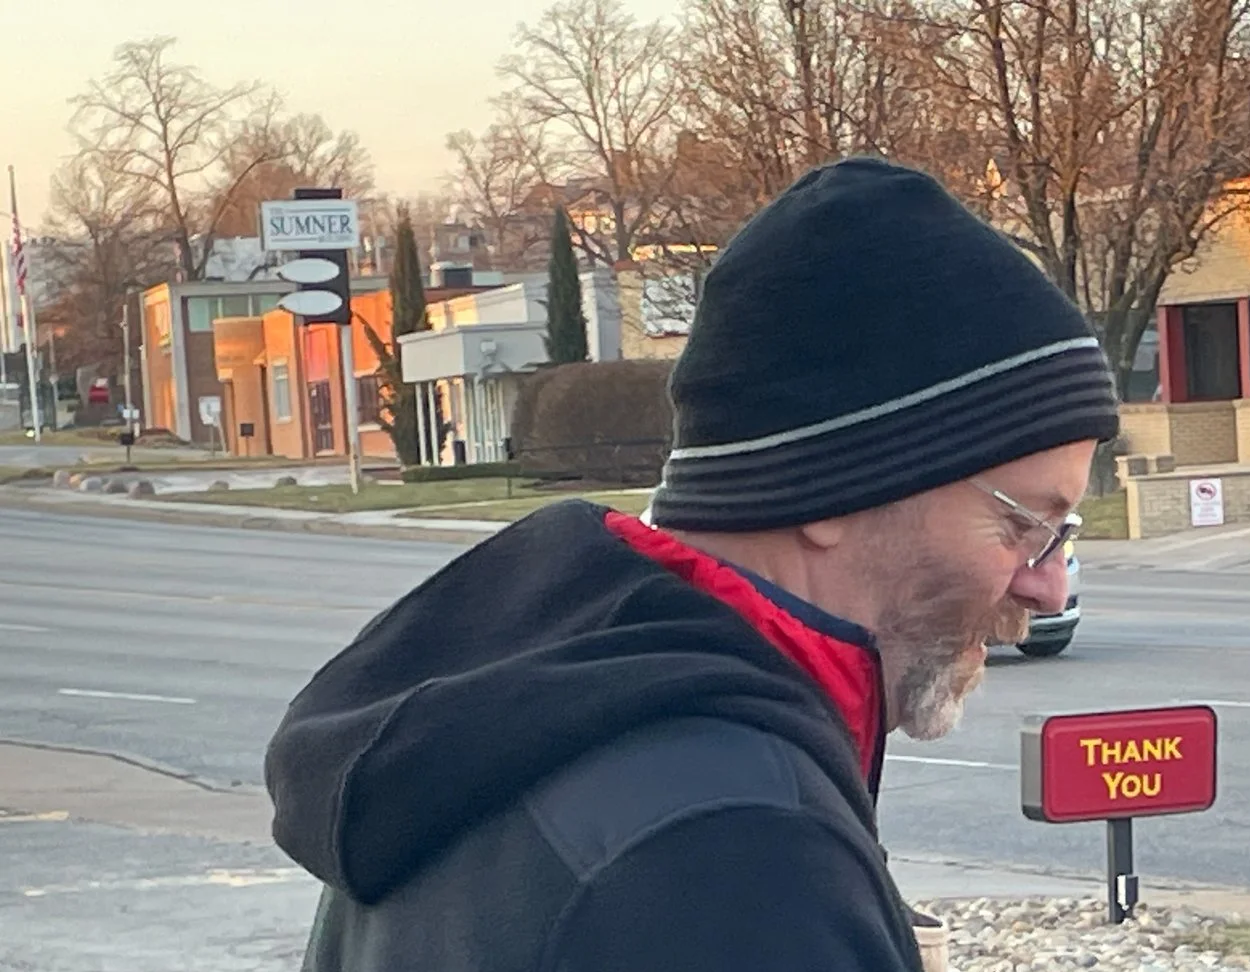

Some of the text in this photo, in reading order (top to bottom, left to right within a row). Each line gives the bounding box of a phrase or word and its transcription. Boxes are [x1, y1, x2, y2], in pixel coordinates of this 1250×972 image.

[270, 214, 352, 236] SUMNER
[1079, 736, 1183, 766] THANK
[1101, 771, 1161, 800] YOU
